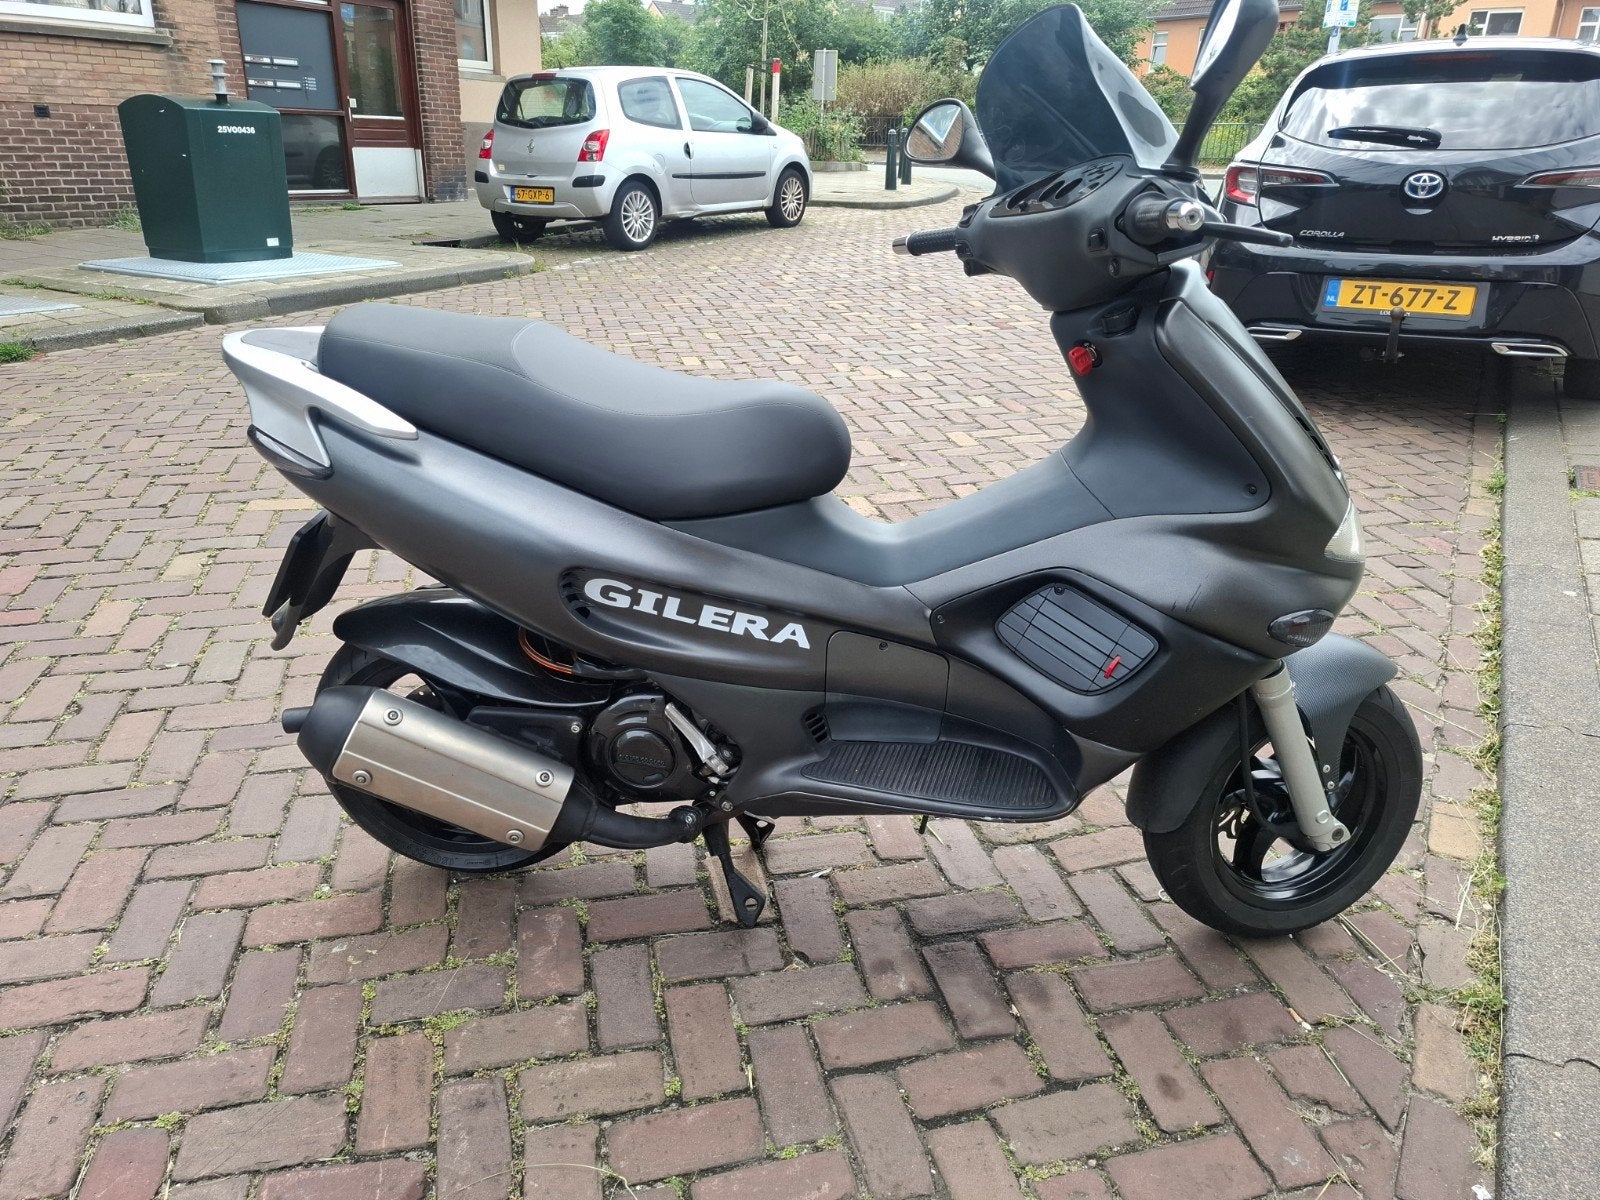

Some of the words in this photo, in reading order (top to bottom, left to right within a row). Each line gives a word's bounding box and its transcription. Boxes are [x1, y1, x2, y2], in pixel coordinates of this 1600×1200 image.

[516, 189, 550, 200] 67-GXP-6
[1299, 229, 1345, 238] COROLLA
[1491, 235, 1532, 243] HYBRID
[1350, 284, 1461, 311] ZT-677-Z
[584, 578, 811, 650] GILERA
